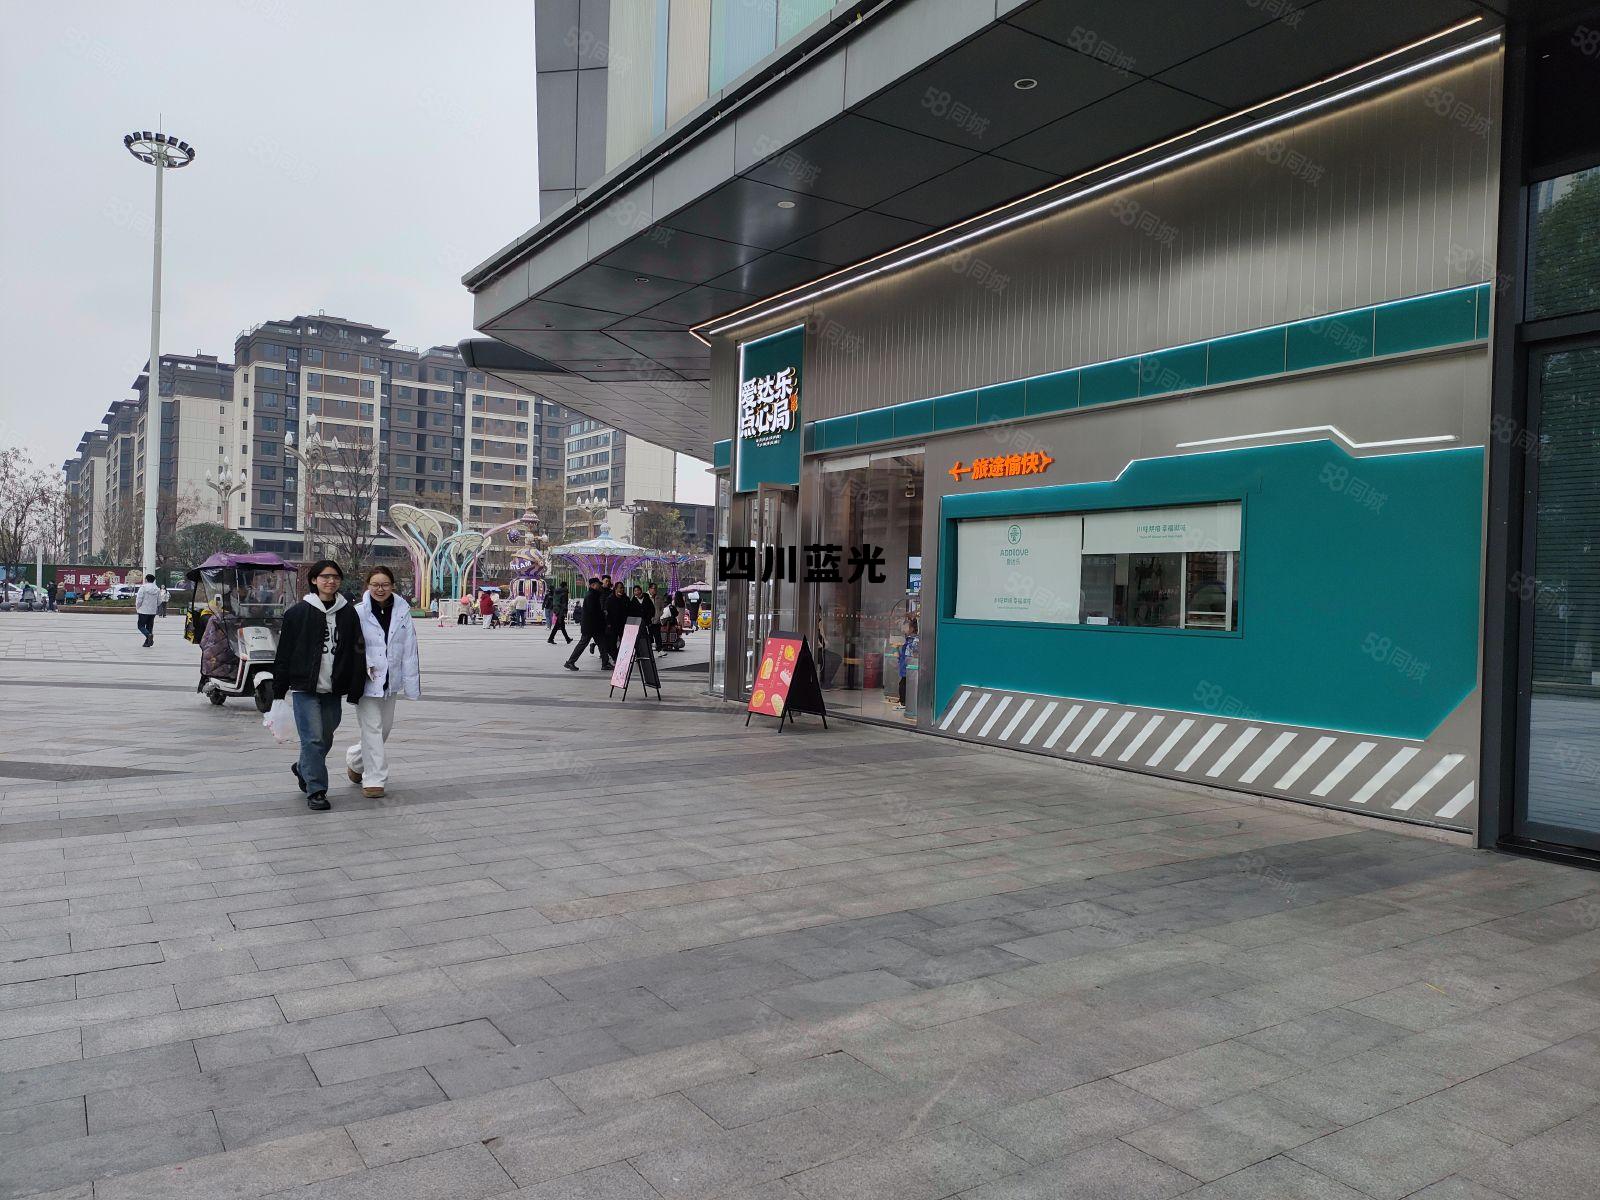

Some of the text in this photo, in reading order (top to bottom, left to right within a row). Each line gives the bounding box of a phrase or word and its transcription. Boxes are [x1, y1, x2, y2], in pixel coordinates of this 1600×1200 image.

[741, 366, 793, 410] 爱达乐
[740, 398, 791, 438] 点心局
[972, 451, 1040, 480] 旅途愉快
